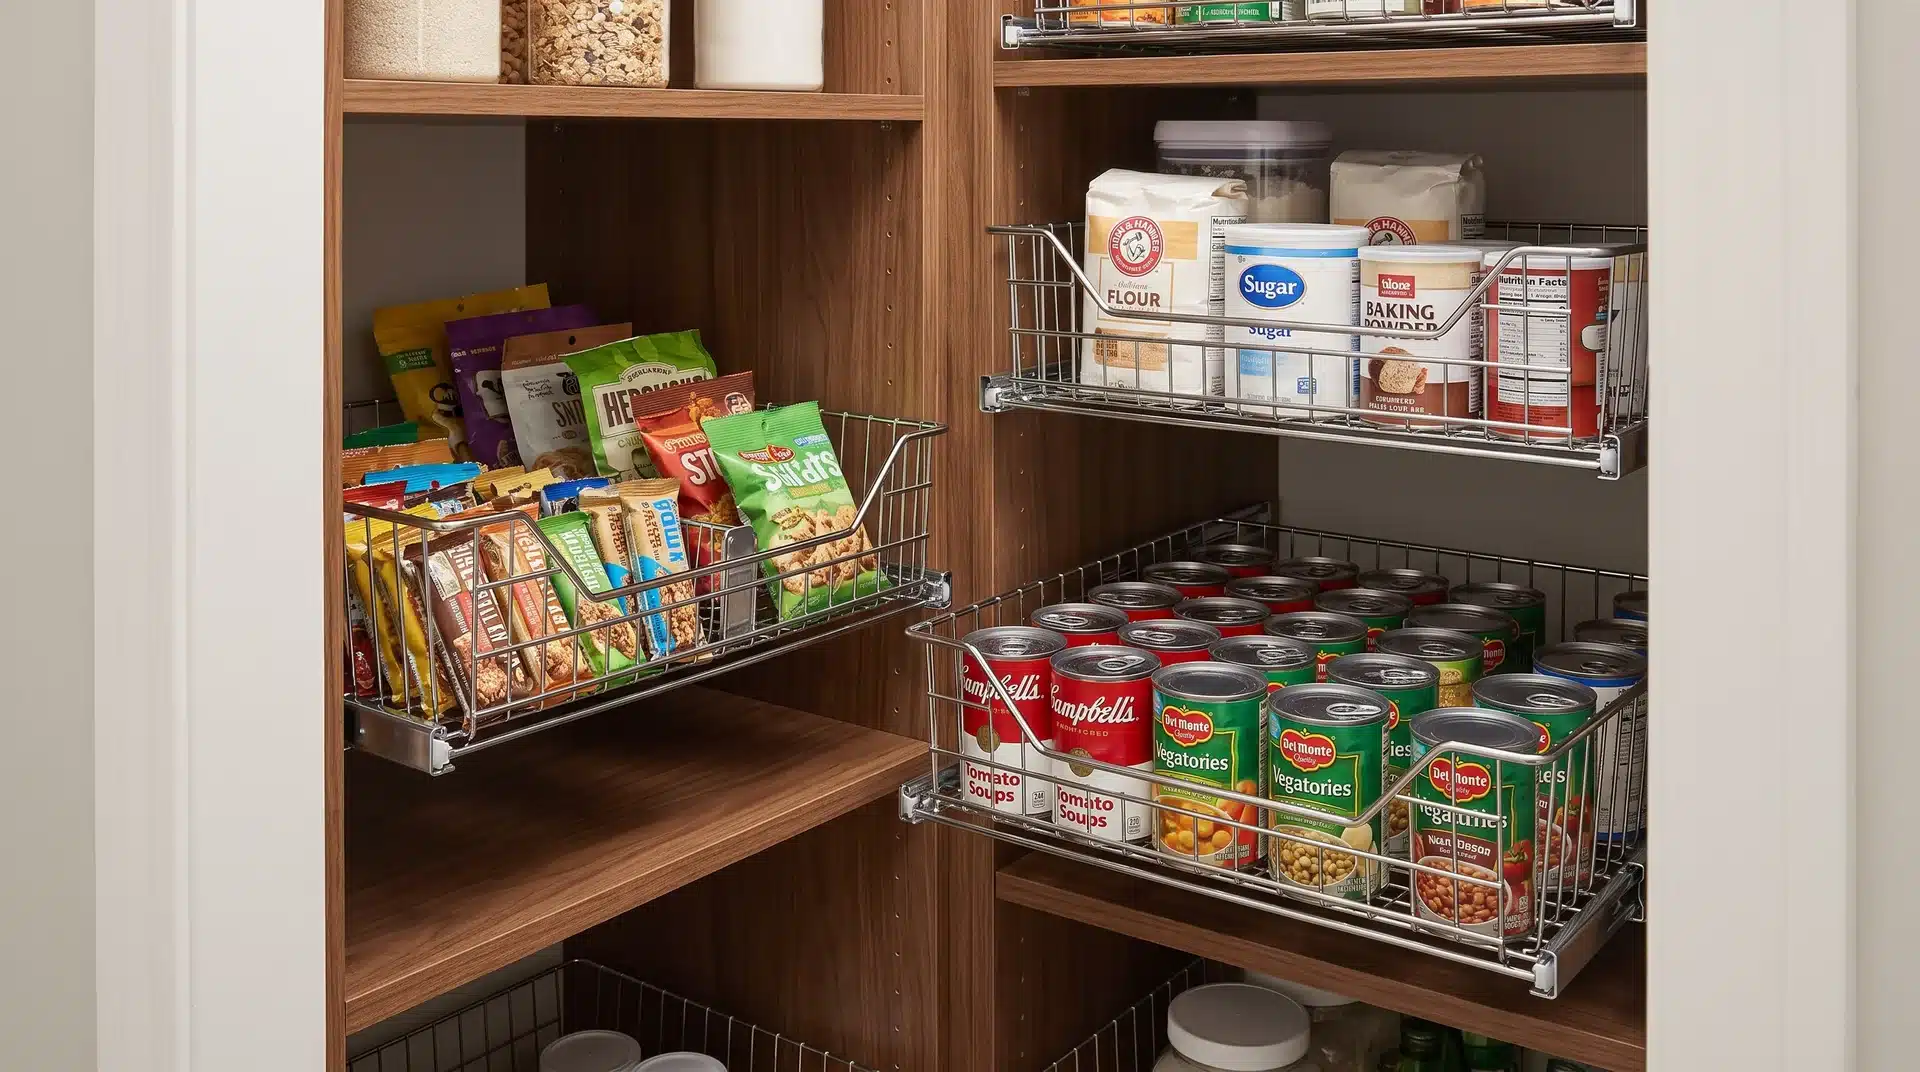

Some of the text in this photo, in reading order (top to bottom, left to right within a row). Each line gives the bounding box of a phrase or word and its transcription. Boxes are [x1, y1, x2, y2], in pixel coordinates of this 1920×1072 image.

[1244, 274, 1298, 299] Sugar
[1499, 274, 1567, 287] Nutritin Facts
[1107, 289, 1161, 307] FLOUR
[1366, 300, 1435, 320] BAKING
[1050, 684, 1136, 726] Campbell's
[1178, 718, 1210, 733] Monte
[1155, 739, 1229, 771] Vegatories
[1298, 742, 1333, 757] Monte
[965, 761, 1021, 787] Tomato
[1272, 764, 1353, 797] Vegatories
[1433, 766, 1450, 782] Del
[969, 780, 1015, 804] Soups
[1057, 784, 1114, 811] Tomato
[1060, 804, 1108, 828] Soups
